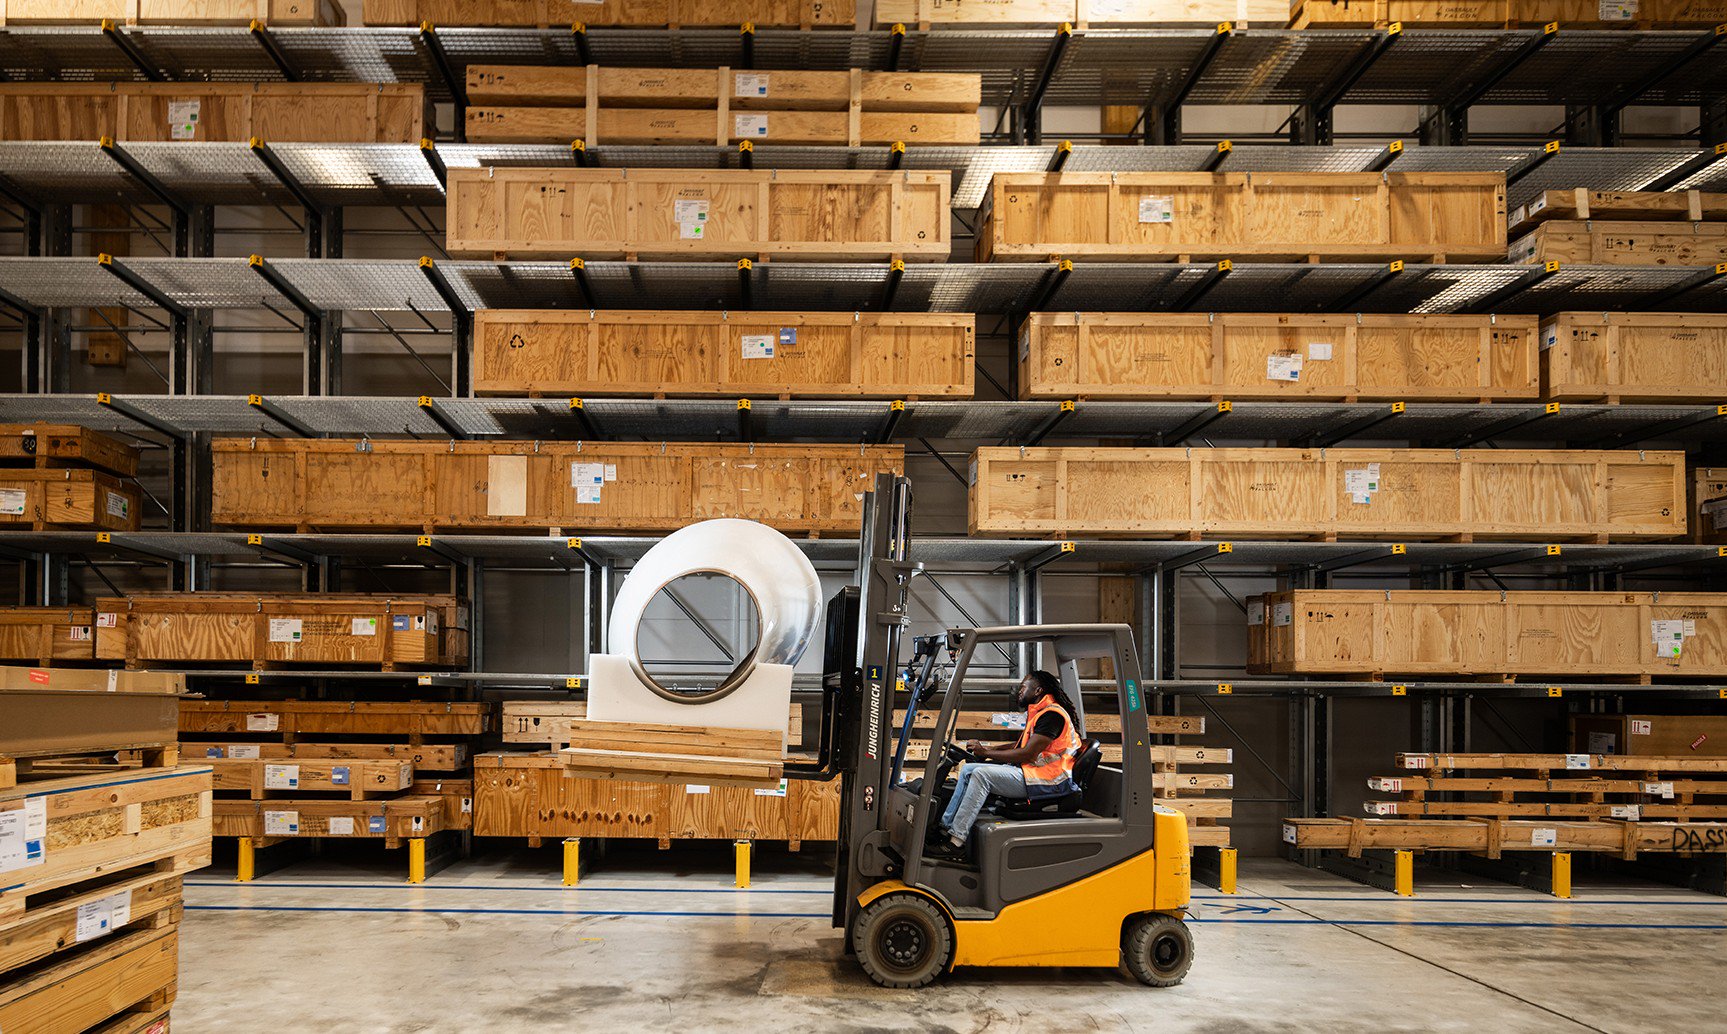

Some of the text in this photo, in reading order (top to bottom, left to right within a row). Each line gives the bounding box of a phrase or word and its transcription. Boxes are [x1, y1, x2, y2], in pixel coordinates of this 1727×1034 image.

[871, 668, 878, 679] 1
[865, 683, 881, 760] JUNGHEINRICH
[1672, 827, 1727, 851] DASS
